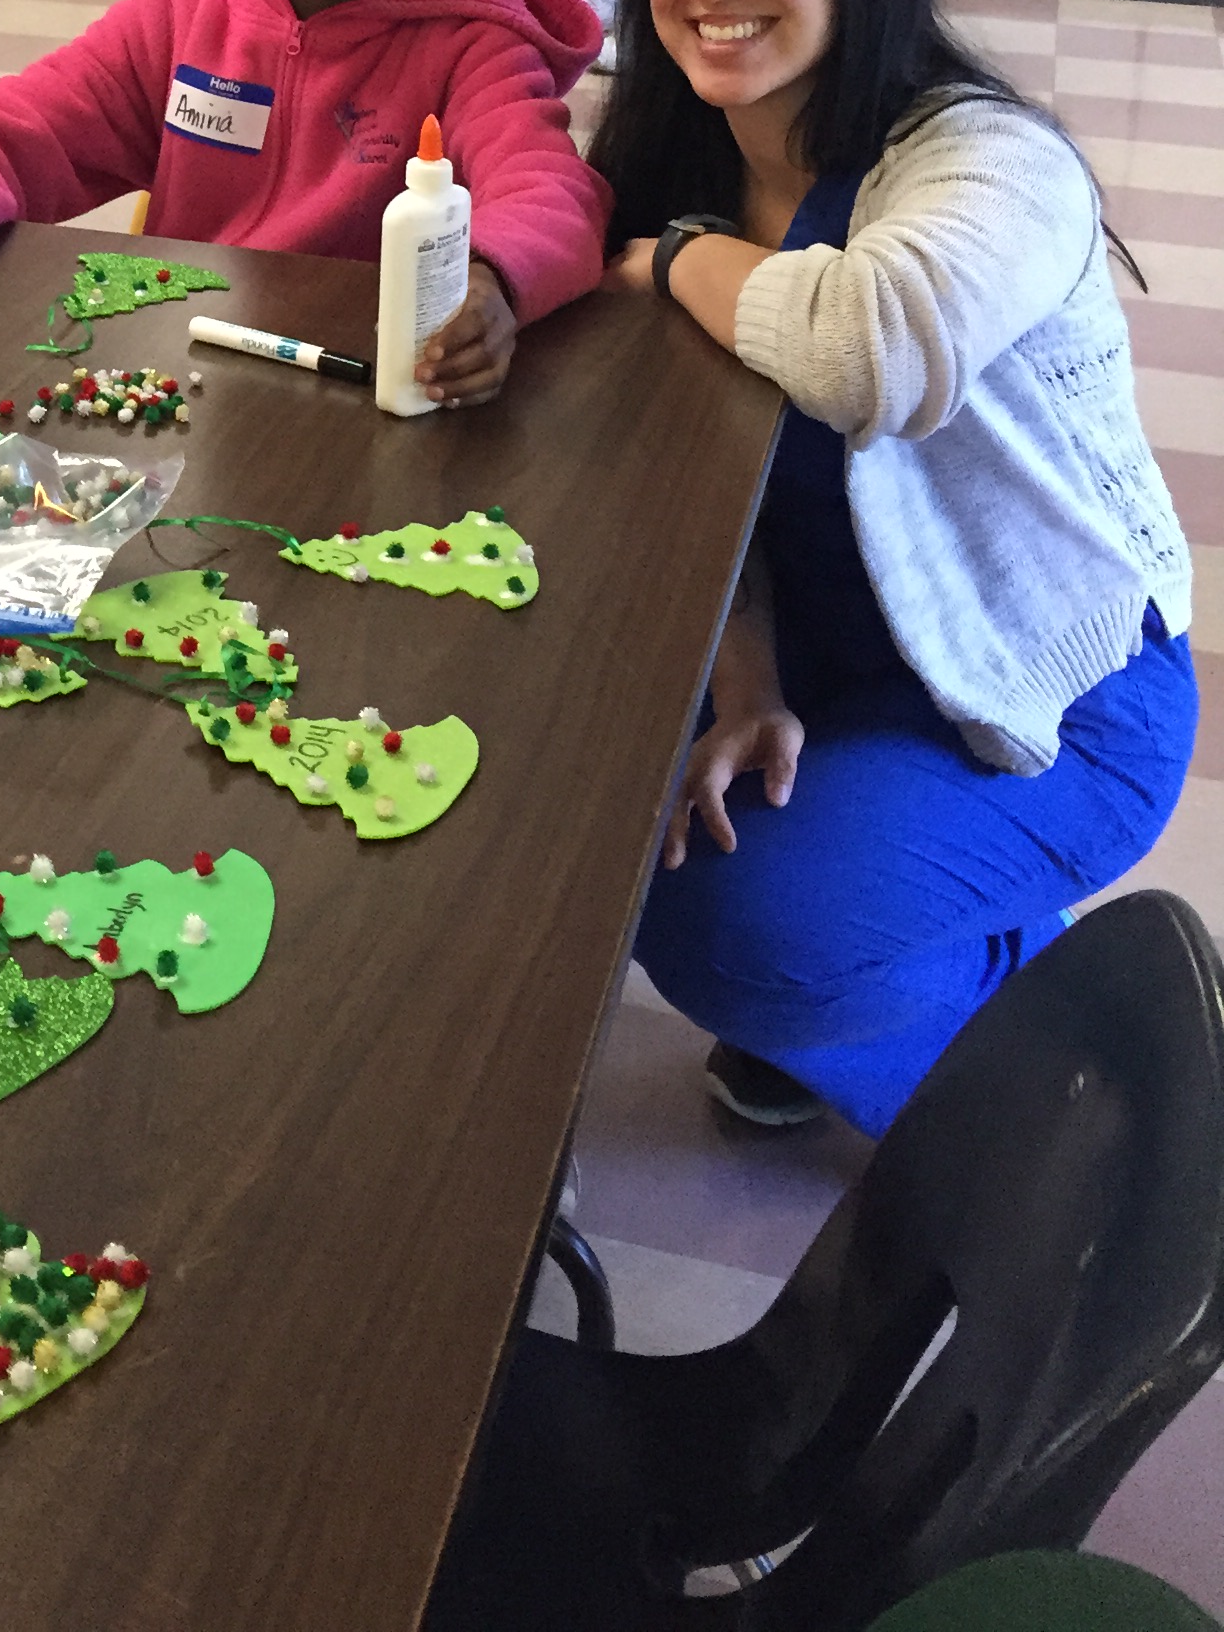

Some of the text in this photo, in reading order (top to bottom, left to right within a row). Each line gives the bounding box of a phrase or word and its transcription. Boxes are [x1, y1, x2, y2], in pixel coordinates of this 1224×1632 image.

[208, 76, 241, 94] Hello
[157, 607, 231, 637] 2014
[288, 724, 348, 774] 2014
[82, 893, 148, 953] berlyn
